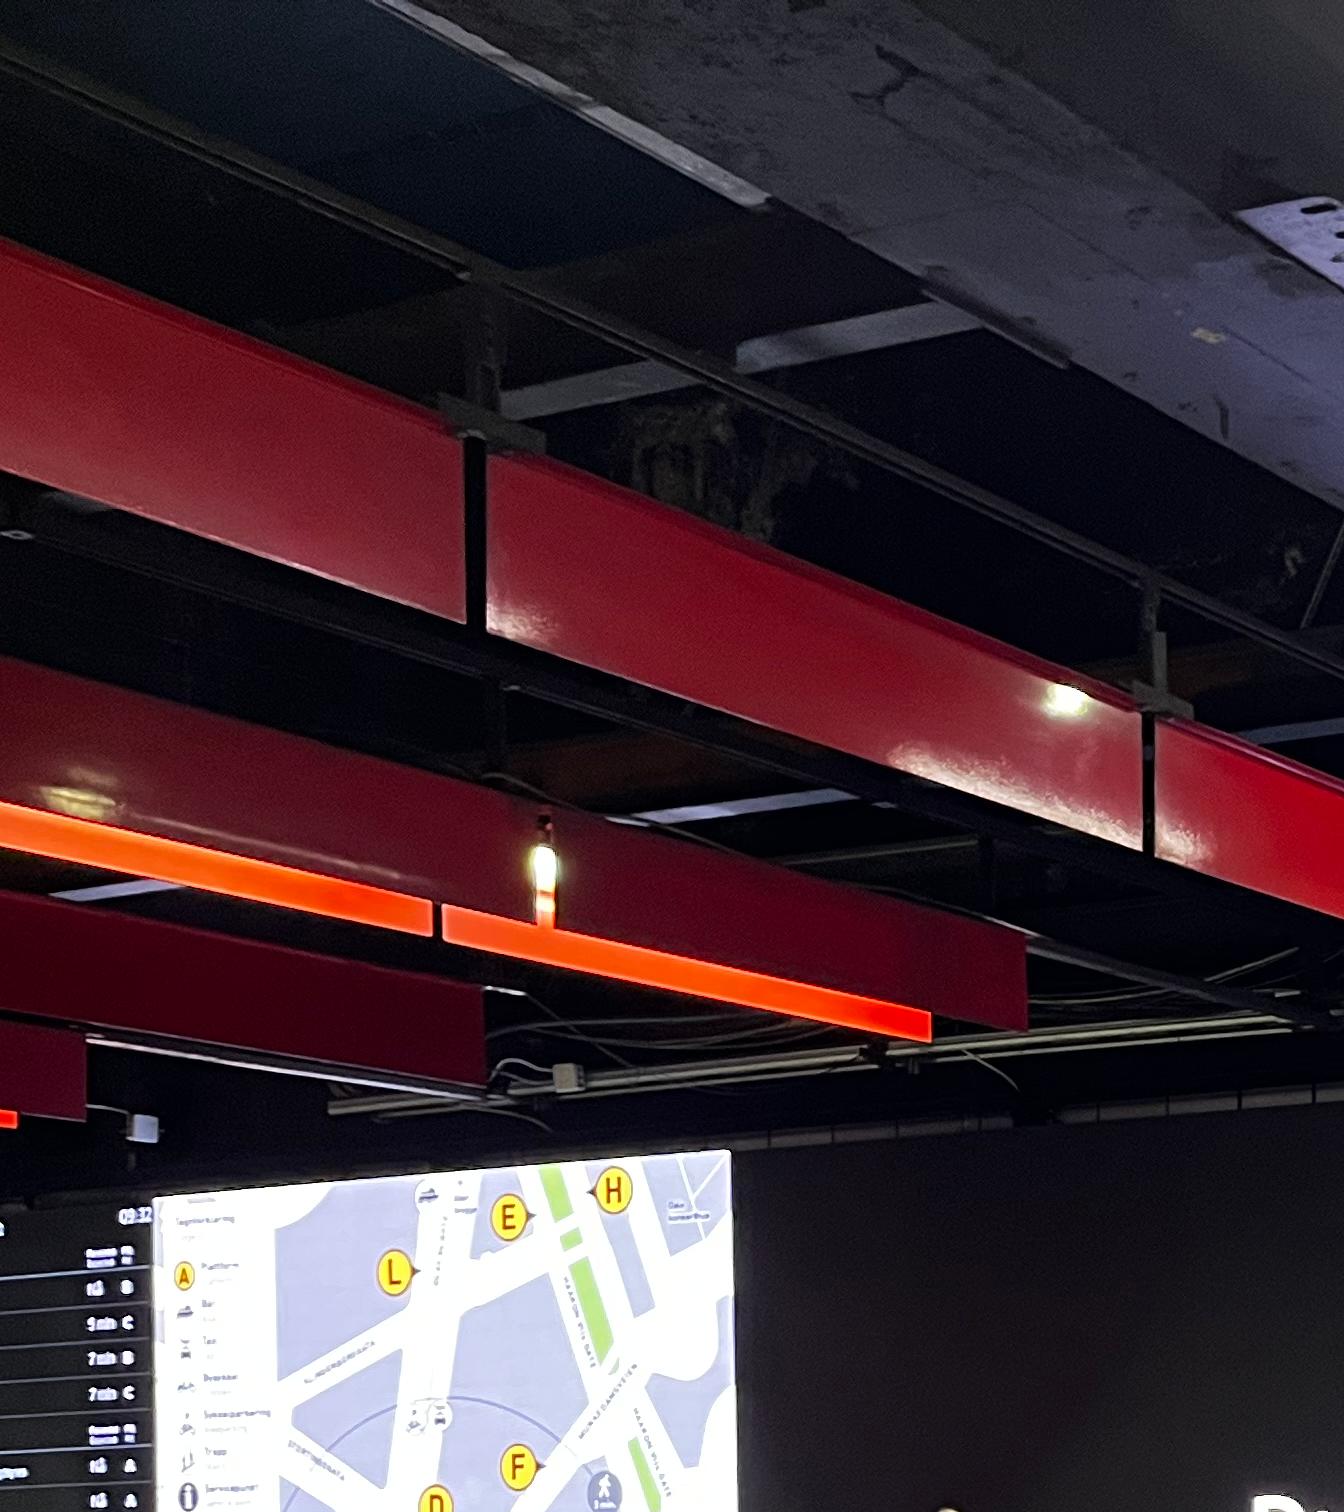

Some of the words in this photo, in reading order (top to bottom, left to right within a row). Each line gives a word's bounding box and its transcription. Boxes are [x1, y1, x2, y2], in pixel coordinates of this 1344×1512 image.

[606, 1177, 621, 1205] H
[502, 1204, 516, 1231] E
[178, 1268, 190, 1285] A
[388, 1259, 402, 1286] L
[511, 1453, 525, 1480] F
